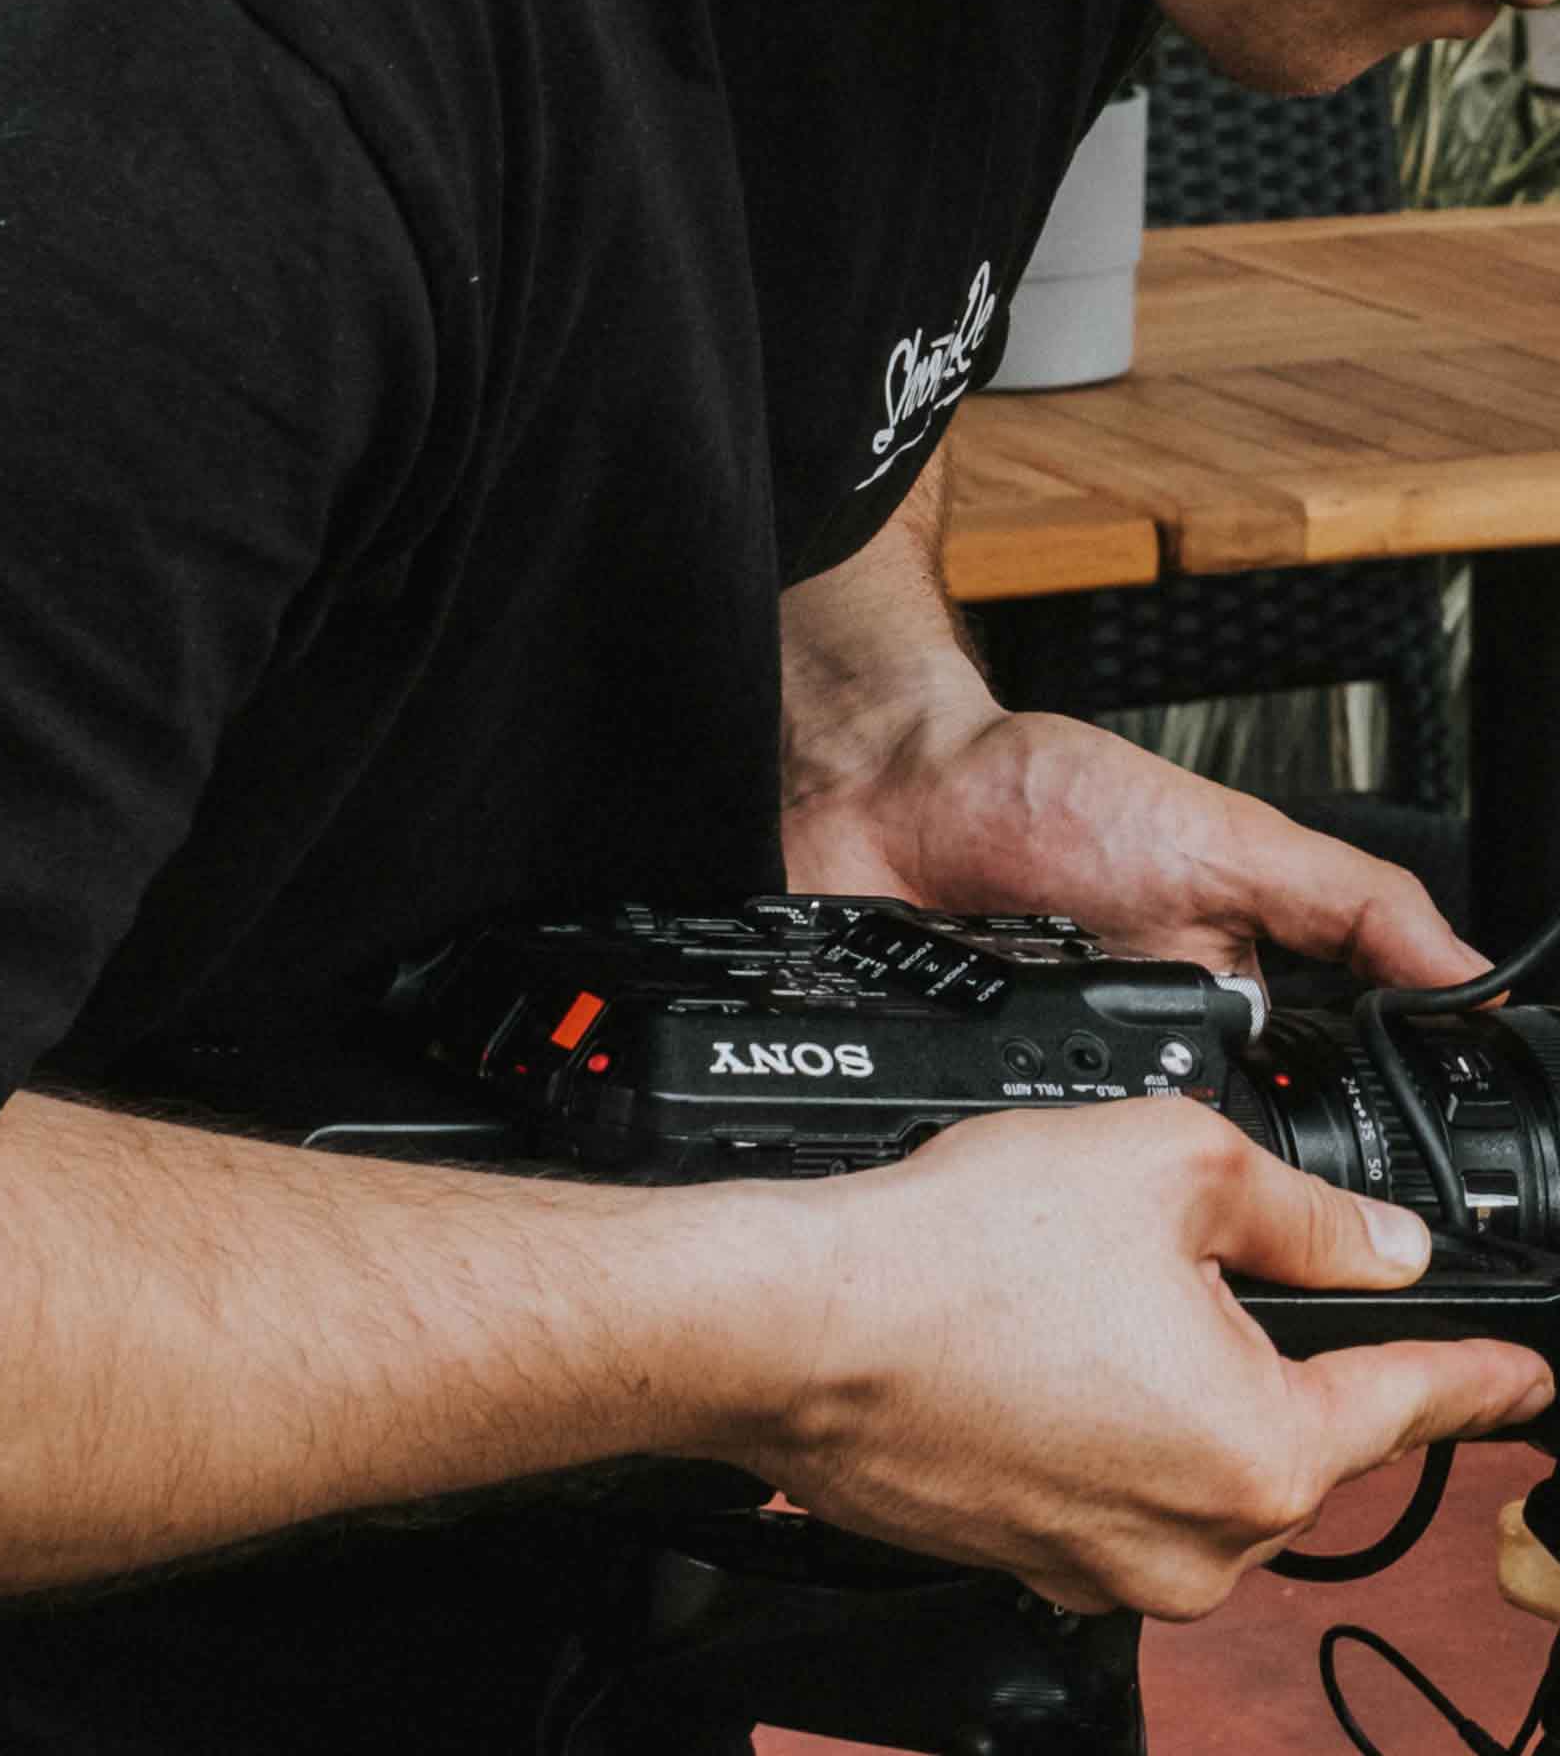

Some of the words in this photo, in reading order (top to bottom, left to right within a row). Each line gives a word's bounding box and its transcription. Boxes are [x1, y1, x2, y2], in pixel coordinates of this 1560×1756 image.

[709, 1041, 874, 1077] SONY
[1003, 1083, 1032, 1097] AUTO
[1034, 1083, 1064, 1097] FULL
[1096, 1084, 1127, 1097] HOLD
[1359, 1118, 1376, 1141] 35
[1366, 1158, 1382, 1181] 50
